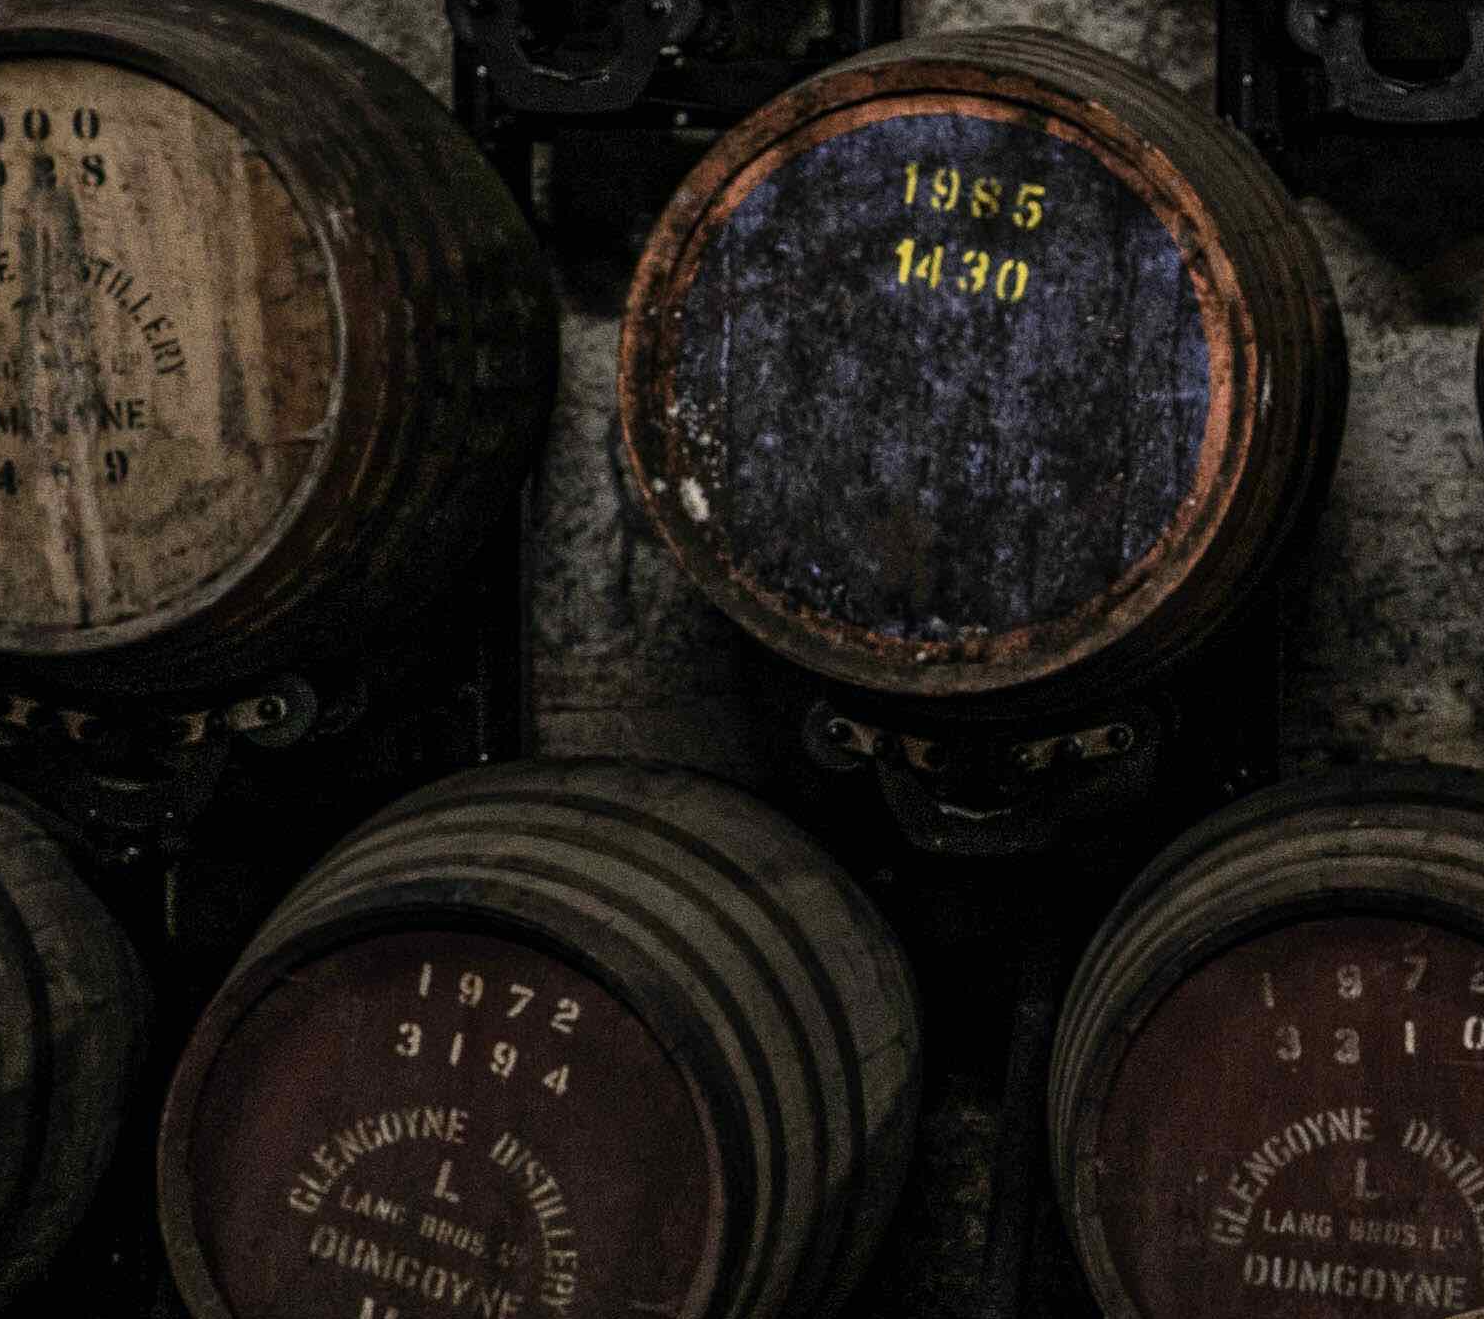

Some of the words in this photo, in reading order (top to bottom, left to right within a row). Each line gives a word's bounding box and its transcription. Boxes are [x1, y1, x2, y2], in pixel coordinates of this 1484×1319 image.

[903, 162, 1047, 230] 1985
[893, 237, 1031, 303] 1430
[417, 961, 581, 1034] 1972
[395, 1022, 571, 1096] 3194
[288, 1105, 469, 1214] GLENGOYNE
[489, 1131, 581, 1317] DISTILLERY
[1213, 1105, 1376, 1247] GLENGOYNE
[339, 1185, 407, 1226] LANG
[418, 1212, 487, 1259] BROS
[1262, 1209, 1334, 1243] LANG
[1241, 1254, 1466, 1311] DUMGOYNE
